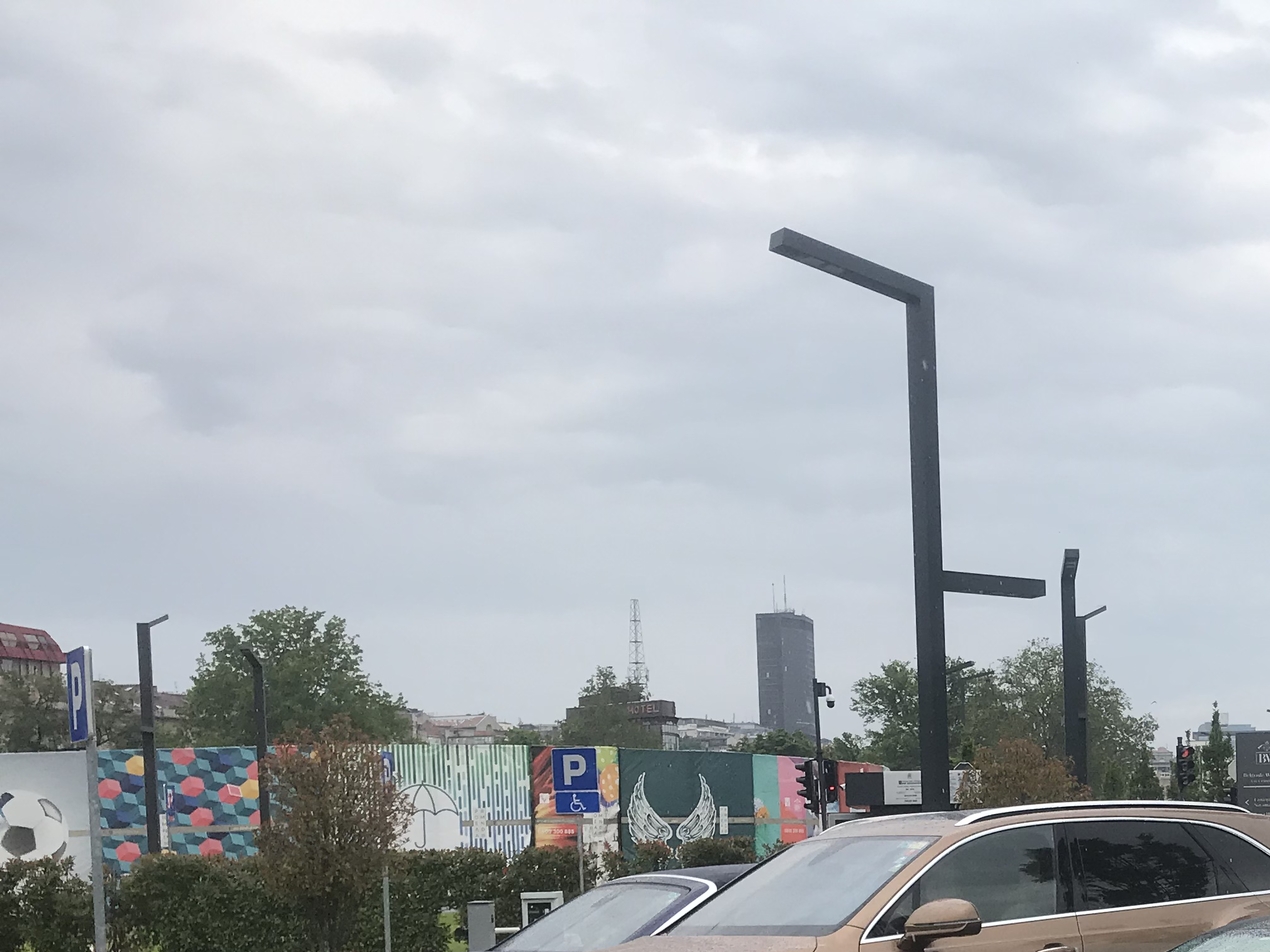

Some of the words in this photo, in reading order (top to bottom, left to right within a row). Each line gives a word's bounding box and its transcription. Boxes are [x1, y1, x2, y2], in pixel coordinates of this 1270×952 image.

[70, 661, 83, 730] P
[627, 704, 660, 715] HOTEL
[562, 754, 587, 786] P
